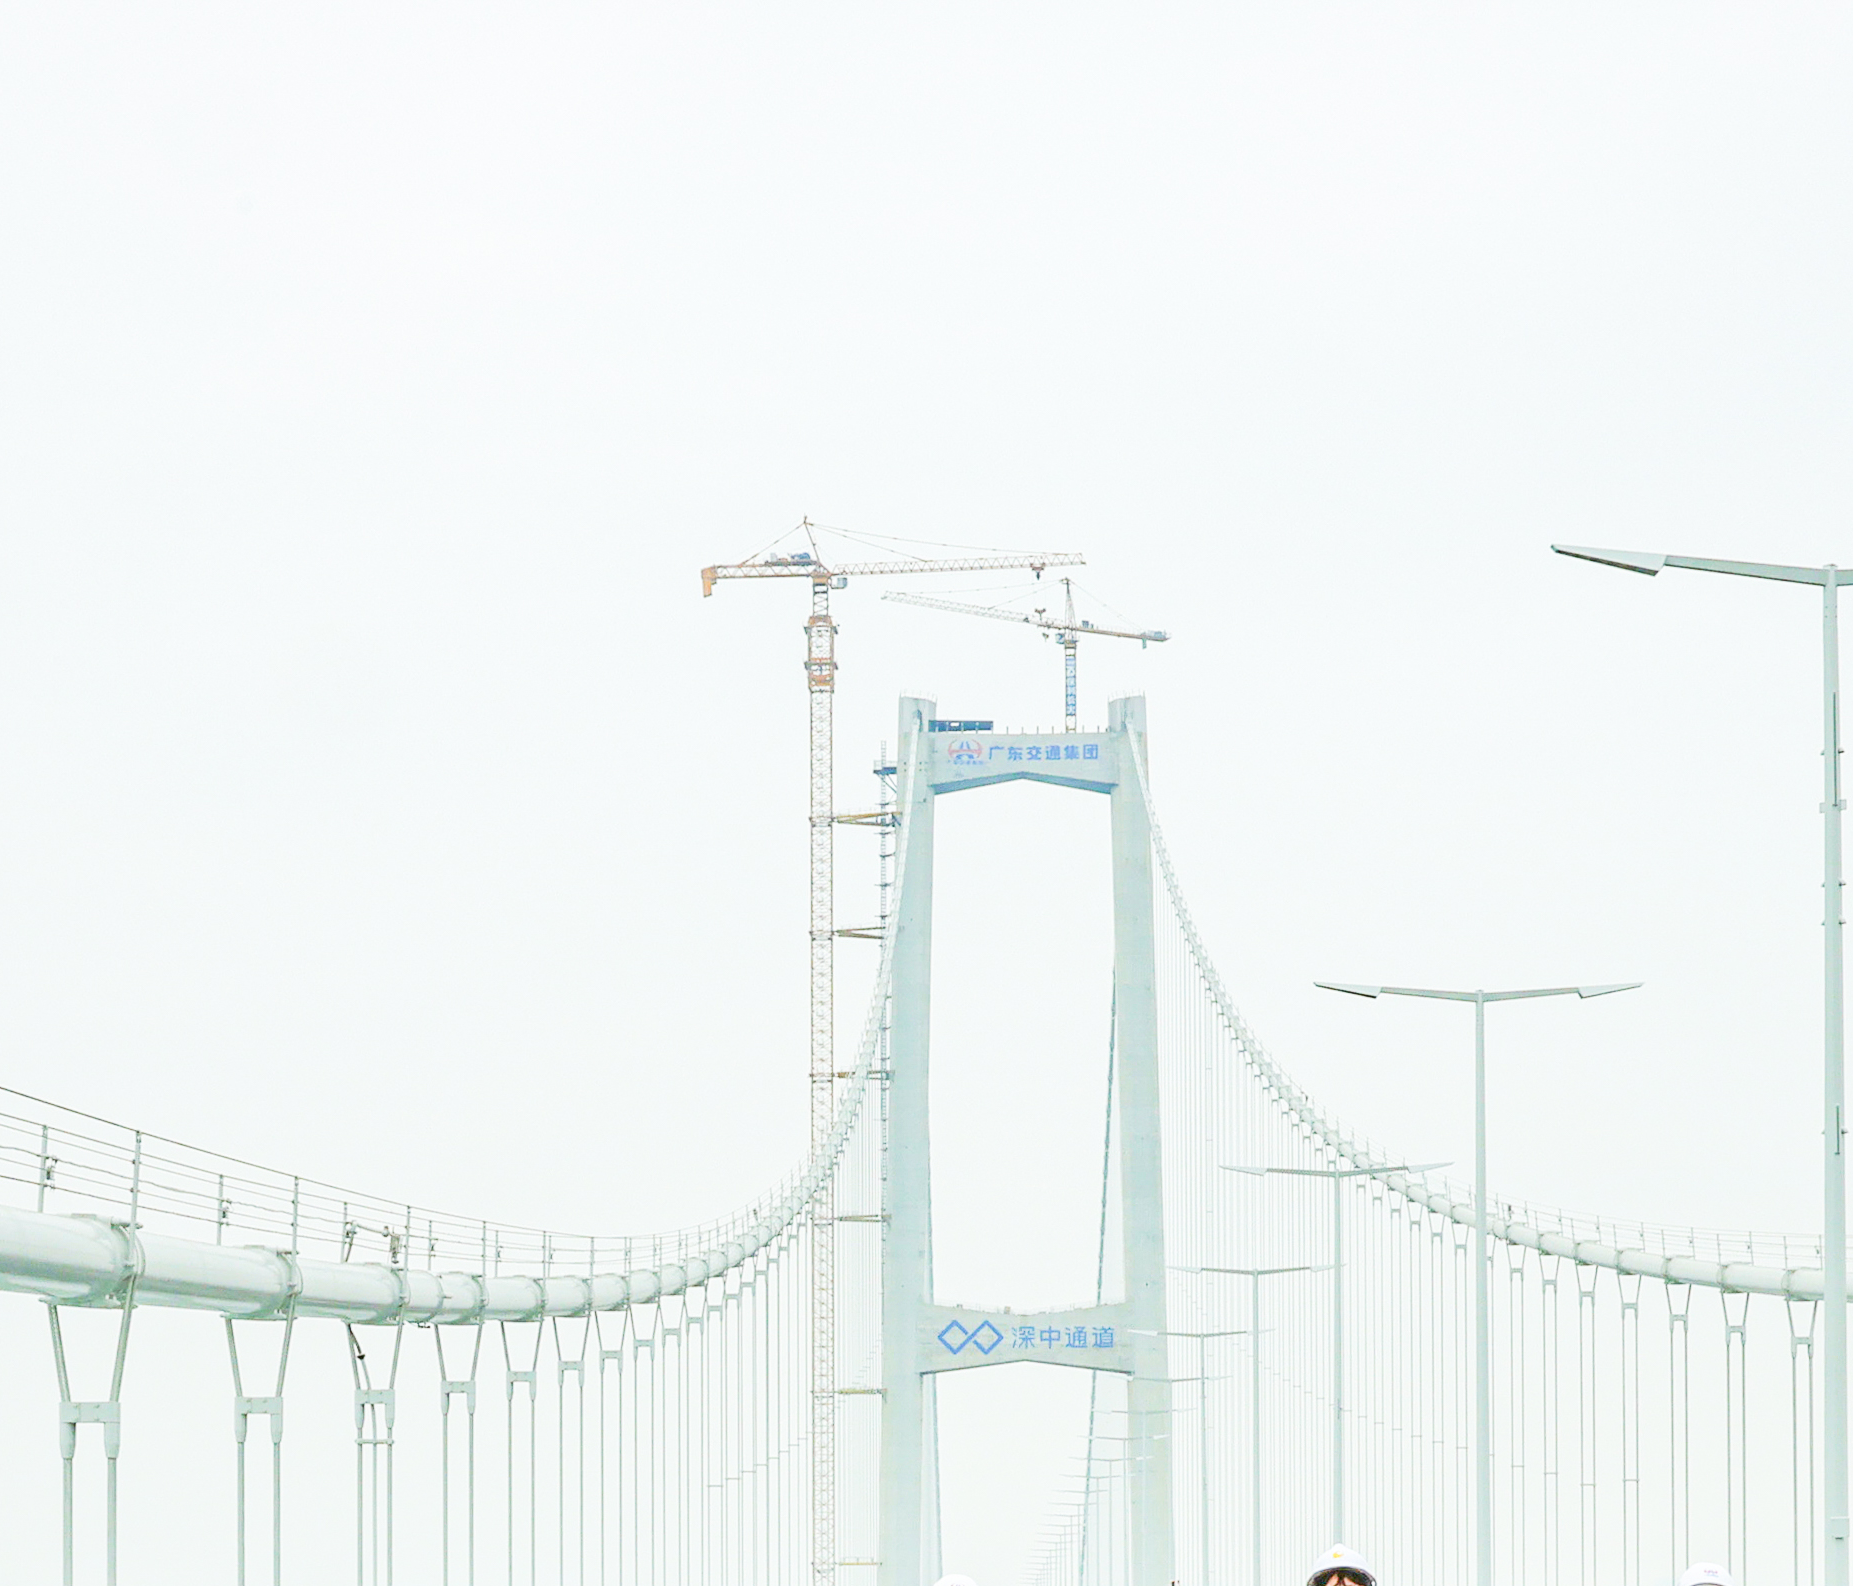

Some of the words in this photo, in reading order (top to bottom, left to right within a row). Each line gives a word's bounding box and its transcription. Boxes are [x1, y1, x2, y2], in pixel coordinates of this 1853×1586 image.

[988, 743, 1098, 761] 广东交通集团
[1011, 1326, 1115, 1349] 深中通道
